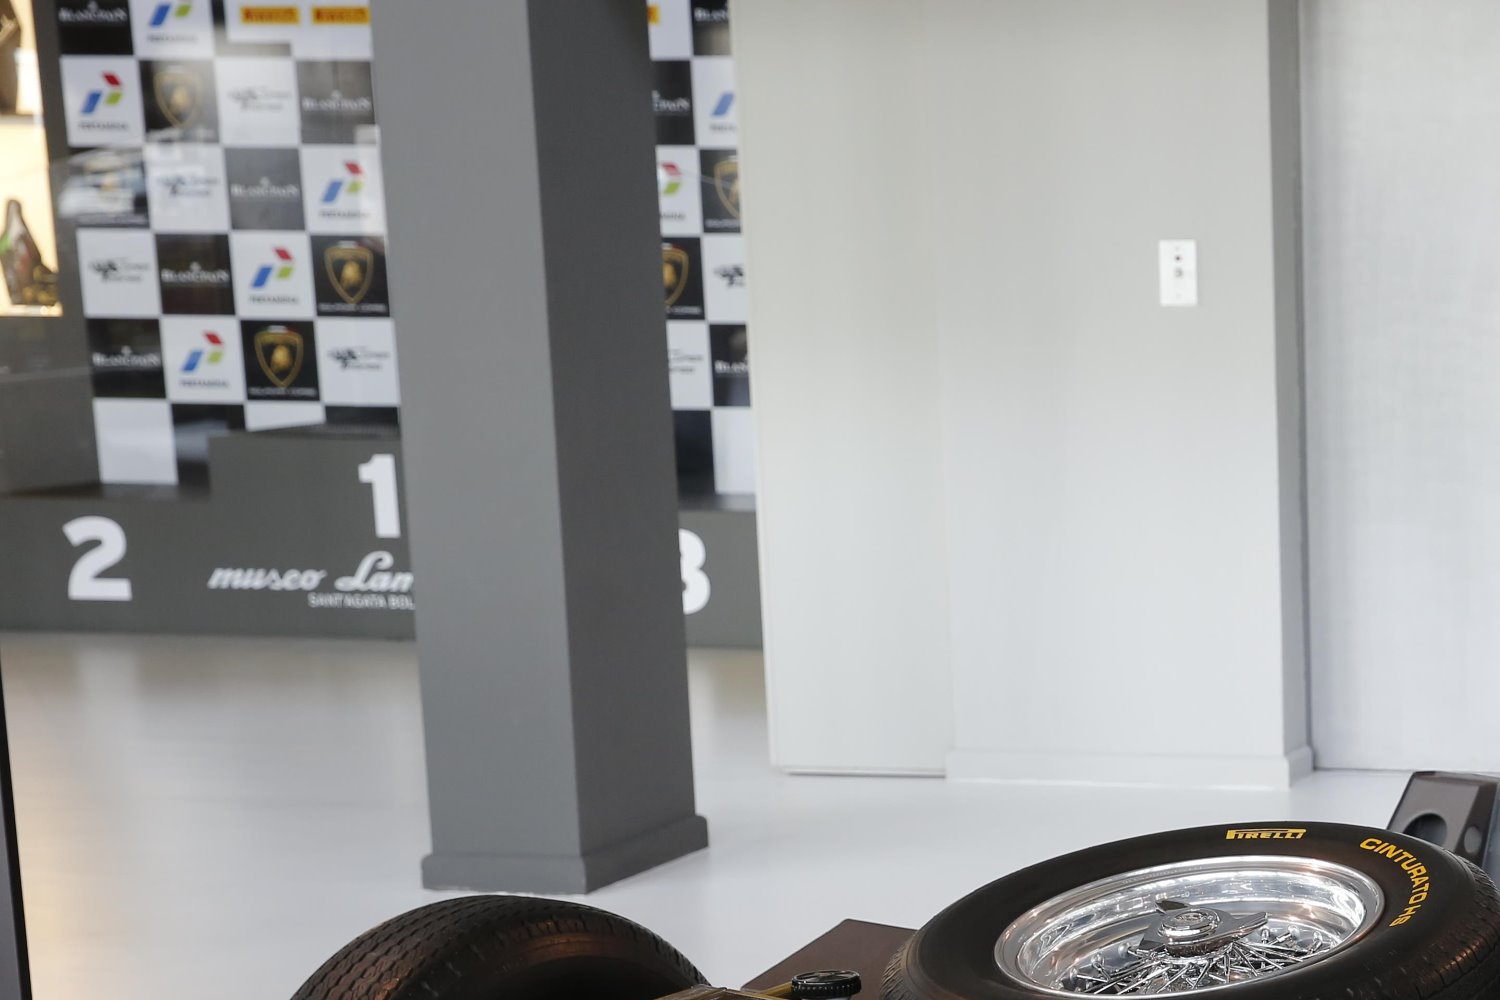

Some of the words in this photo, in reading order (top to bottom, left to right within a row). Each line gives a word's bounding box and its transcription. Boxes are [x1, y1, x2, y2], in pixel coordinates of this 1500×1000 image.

[358, 453, 400, 538] 1
[62, 515, 132, 601] 2
[1225, 829, 1307, 839] PIRELLI
[1360, 838, 1430, 904] CINTURATO
[1389, 905, 1422, 927] HS
